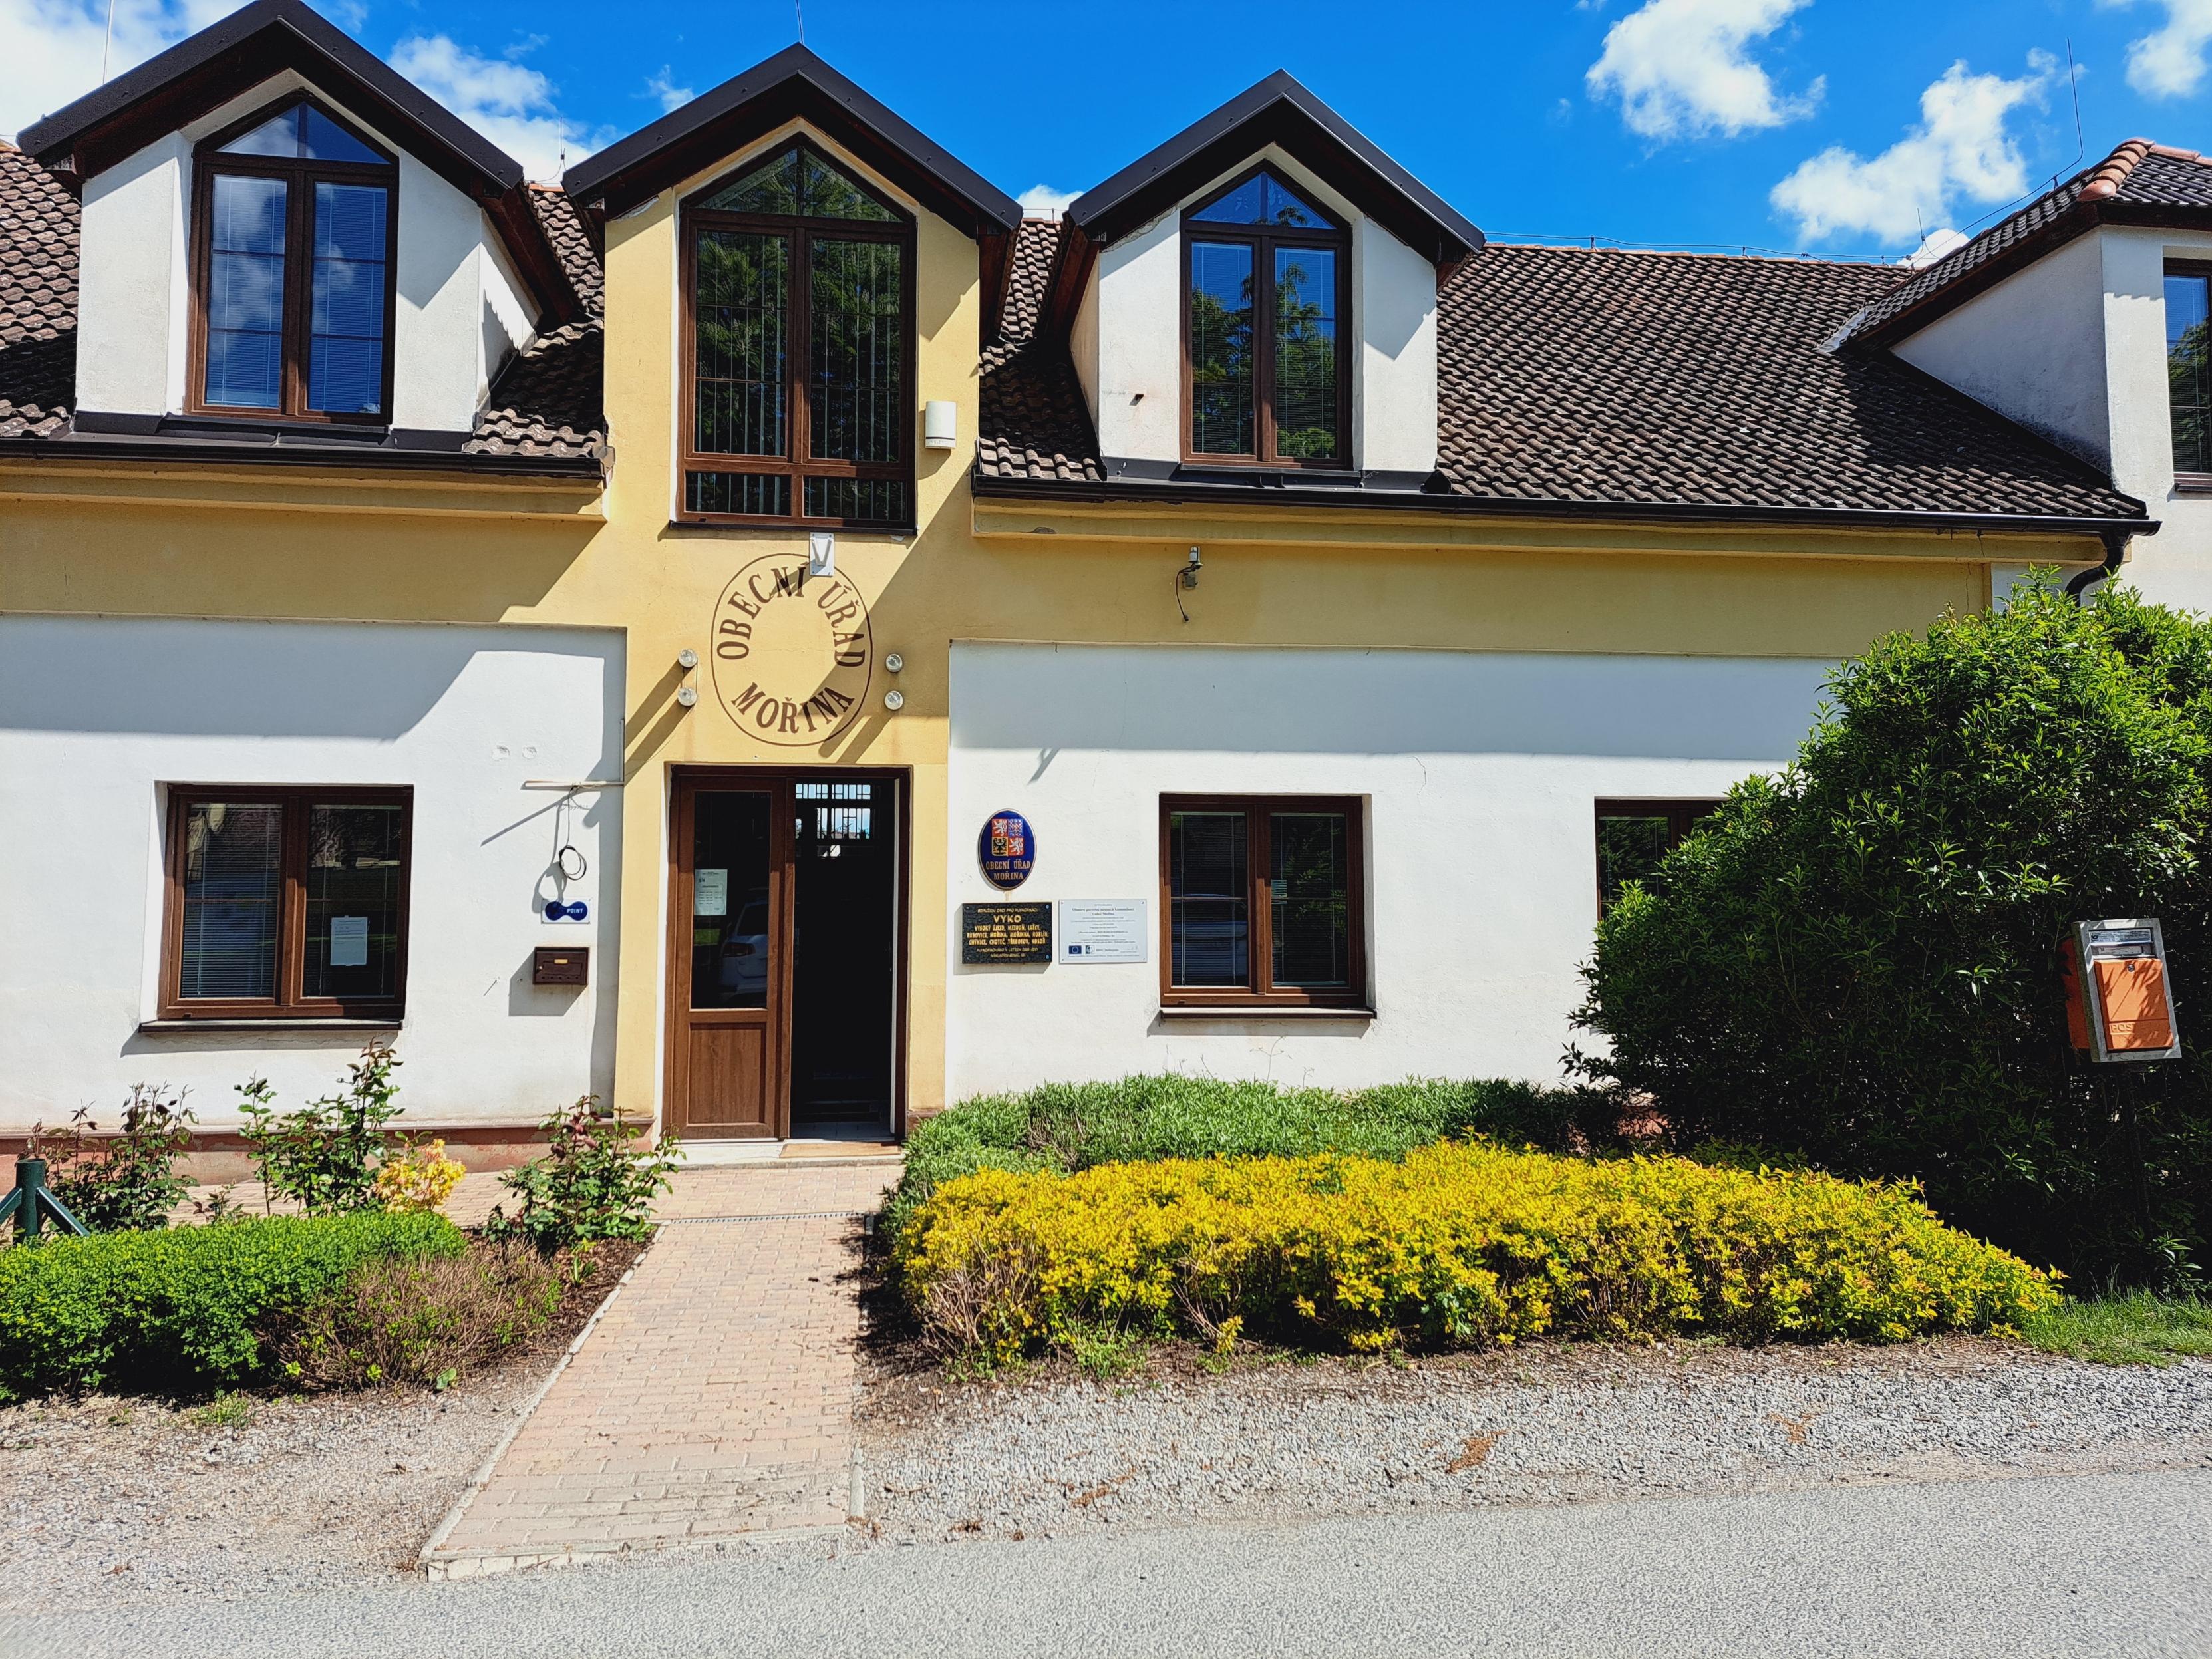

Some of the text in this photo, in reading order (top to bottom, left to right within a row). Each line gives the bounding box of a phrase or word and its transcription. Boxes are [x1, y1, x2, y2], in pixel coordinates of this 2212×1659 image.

[716, 561, 866, 667] OBECNÍ ÚŘAD
[731, 682, 856, 734] MOŘINA
[986, 858, 1030, 869] OBECNÍ ÚŘAD
[994, 871, 1023, 879] MOŘINA
